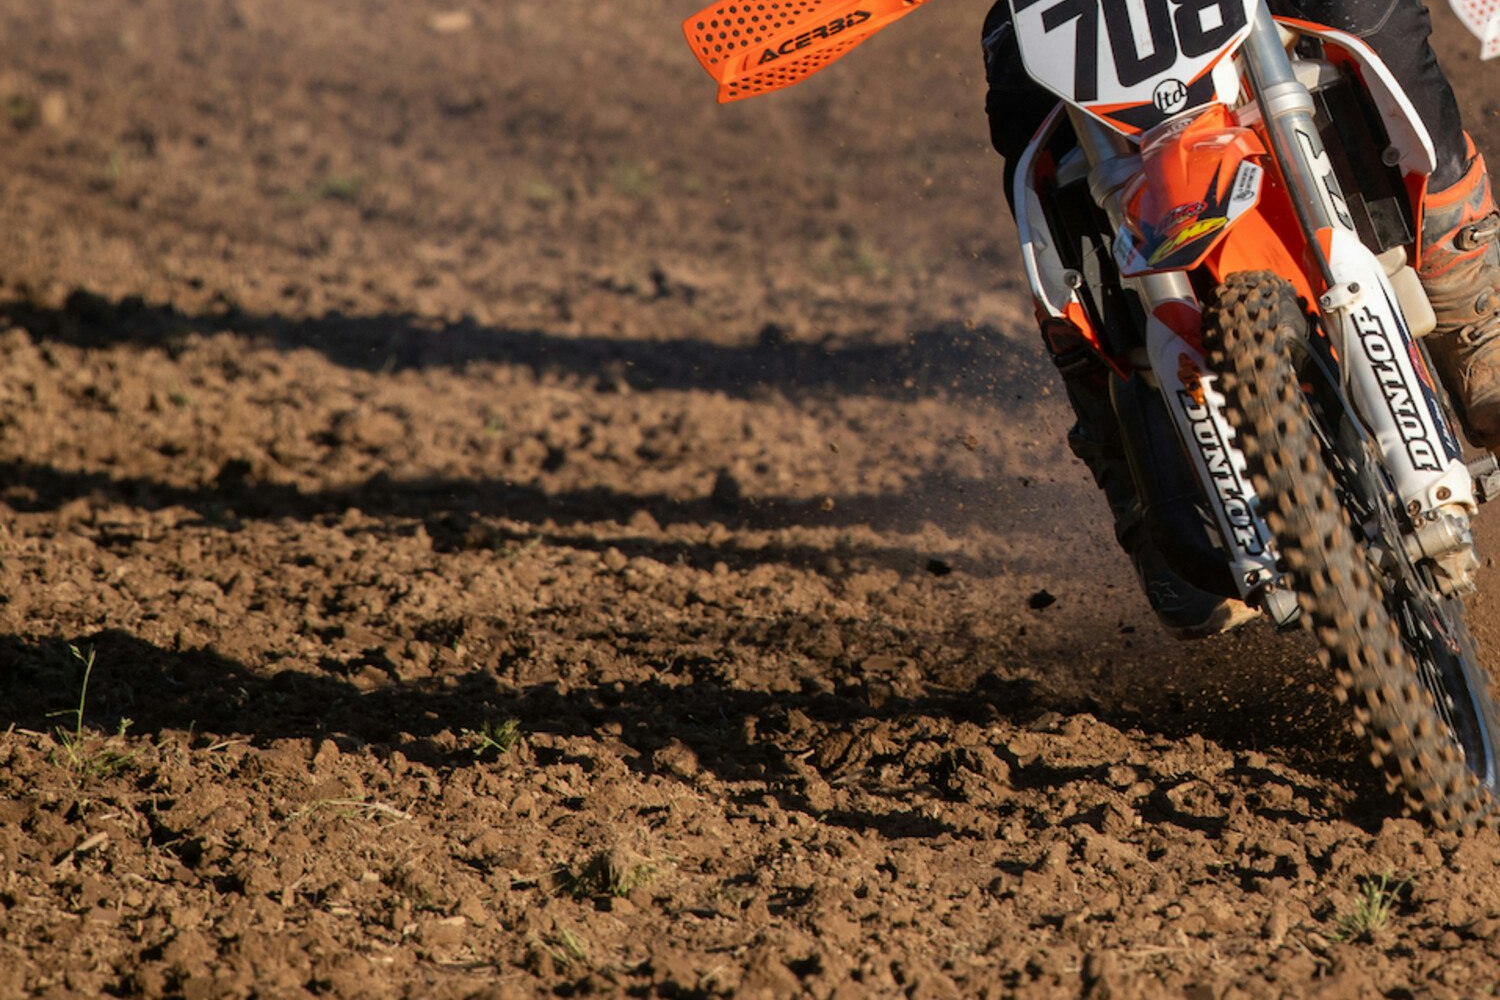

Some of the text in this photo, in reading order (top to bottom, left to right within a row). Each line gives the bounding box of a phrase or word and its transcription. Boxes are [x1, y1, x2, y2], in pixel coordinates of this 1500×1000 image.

[757, 9, 872, 66] ACERBIS
[1154, 79, 1189, 112] ltd
[1350, 307, 1443, 473] DUNLOP
[1177, 388, 1265, 556] DUNLOP
